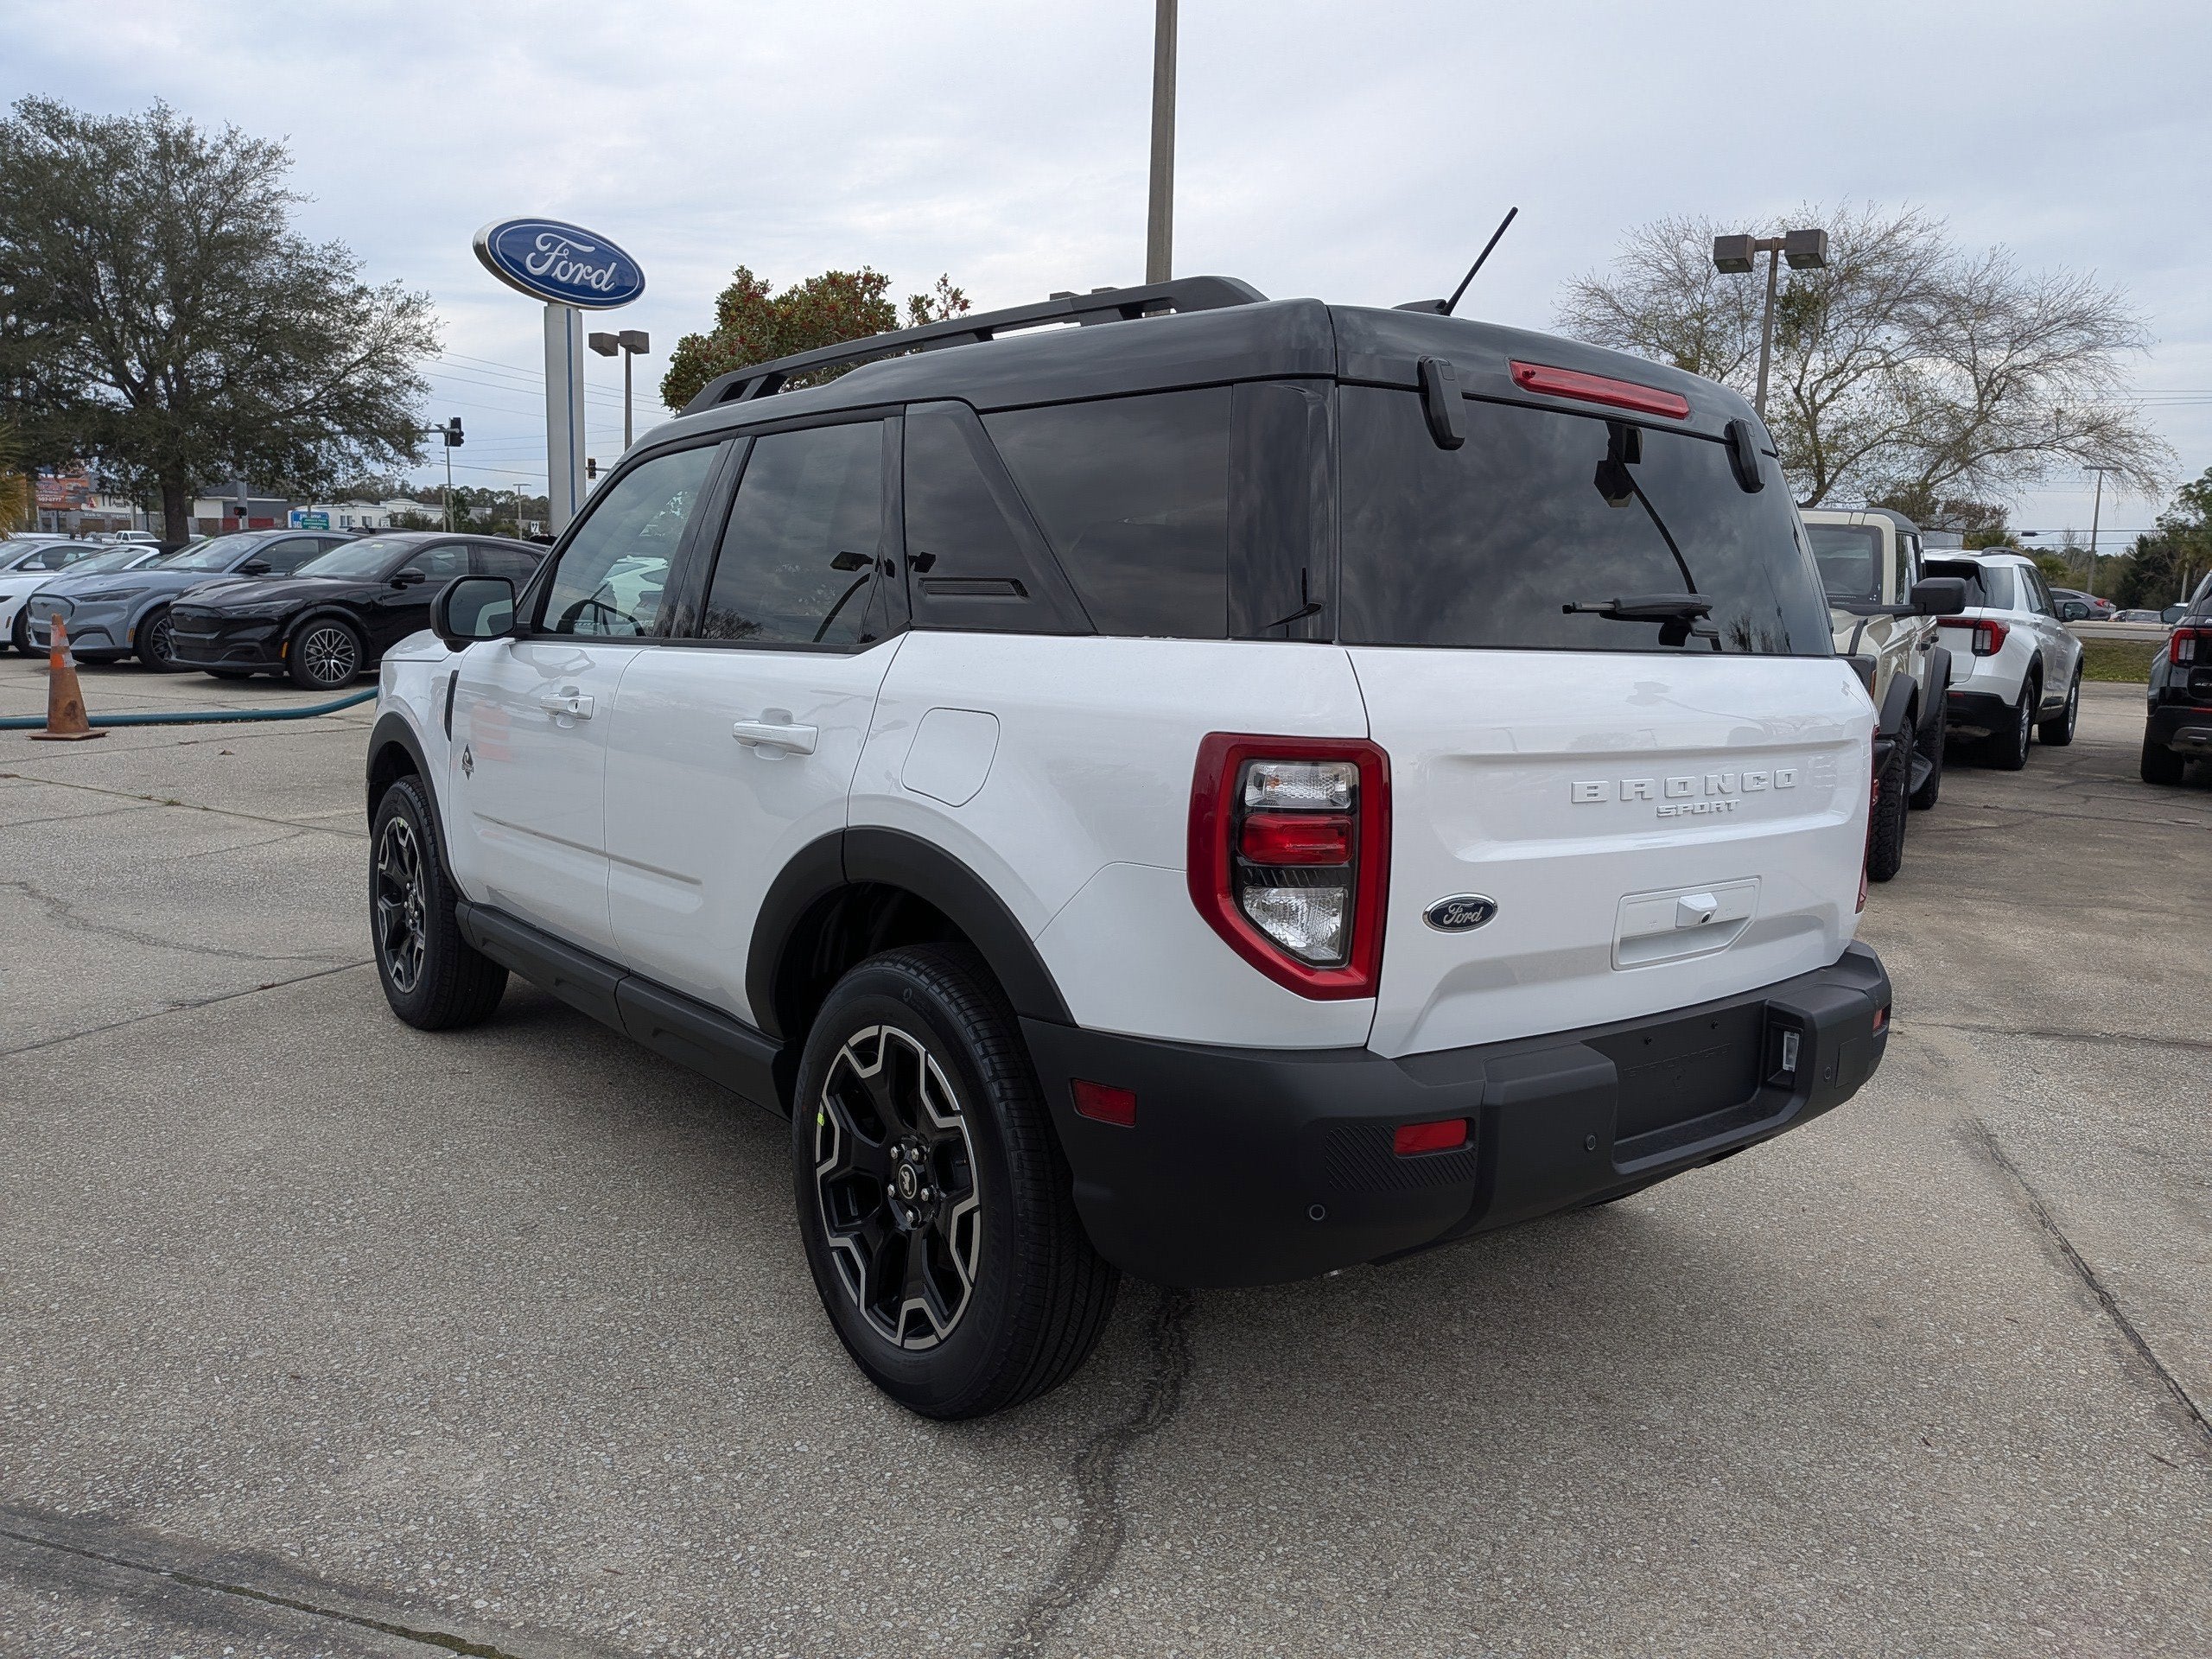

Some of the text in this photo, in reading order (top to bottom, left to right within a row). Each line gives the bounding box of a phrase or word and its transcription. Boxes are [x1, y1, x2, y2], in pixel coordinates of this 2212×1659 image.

[525, 232, 617, 292] Ford
[1571, 768, 1798, 804] BRONCO
[1656, 798, 1740, 818] SPORT
[1442, 902, 1484, 925] Ford
